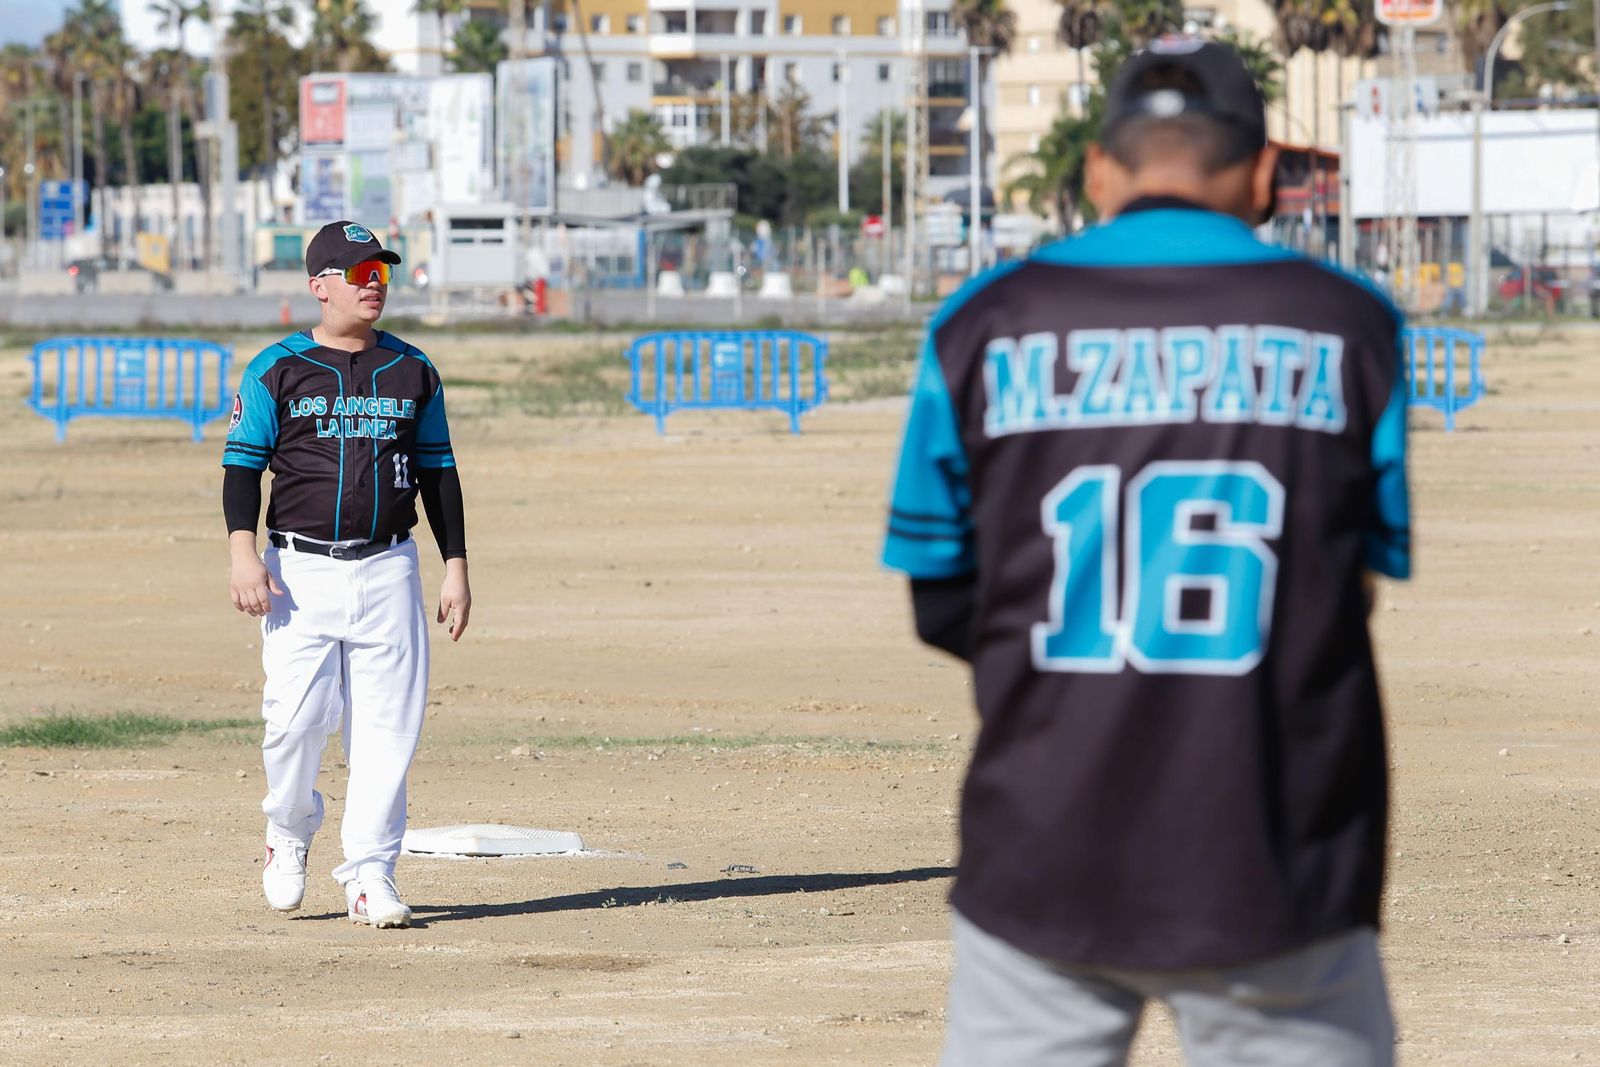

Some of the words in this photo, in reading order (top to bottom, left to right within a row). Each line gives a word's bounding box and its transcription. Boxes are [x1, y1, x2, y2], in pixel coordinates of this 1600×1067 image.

[984, 325, 1346, 438] M.ZAPATA
[289, 396, 327, 418] LOS
[316, 418, 340, 438] LA
[345, 417, 397, 439] LINEA
[393, 453, 411, 488] 11
[1031, 461, 1286, 675] 16
